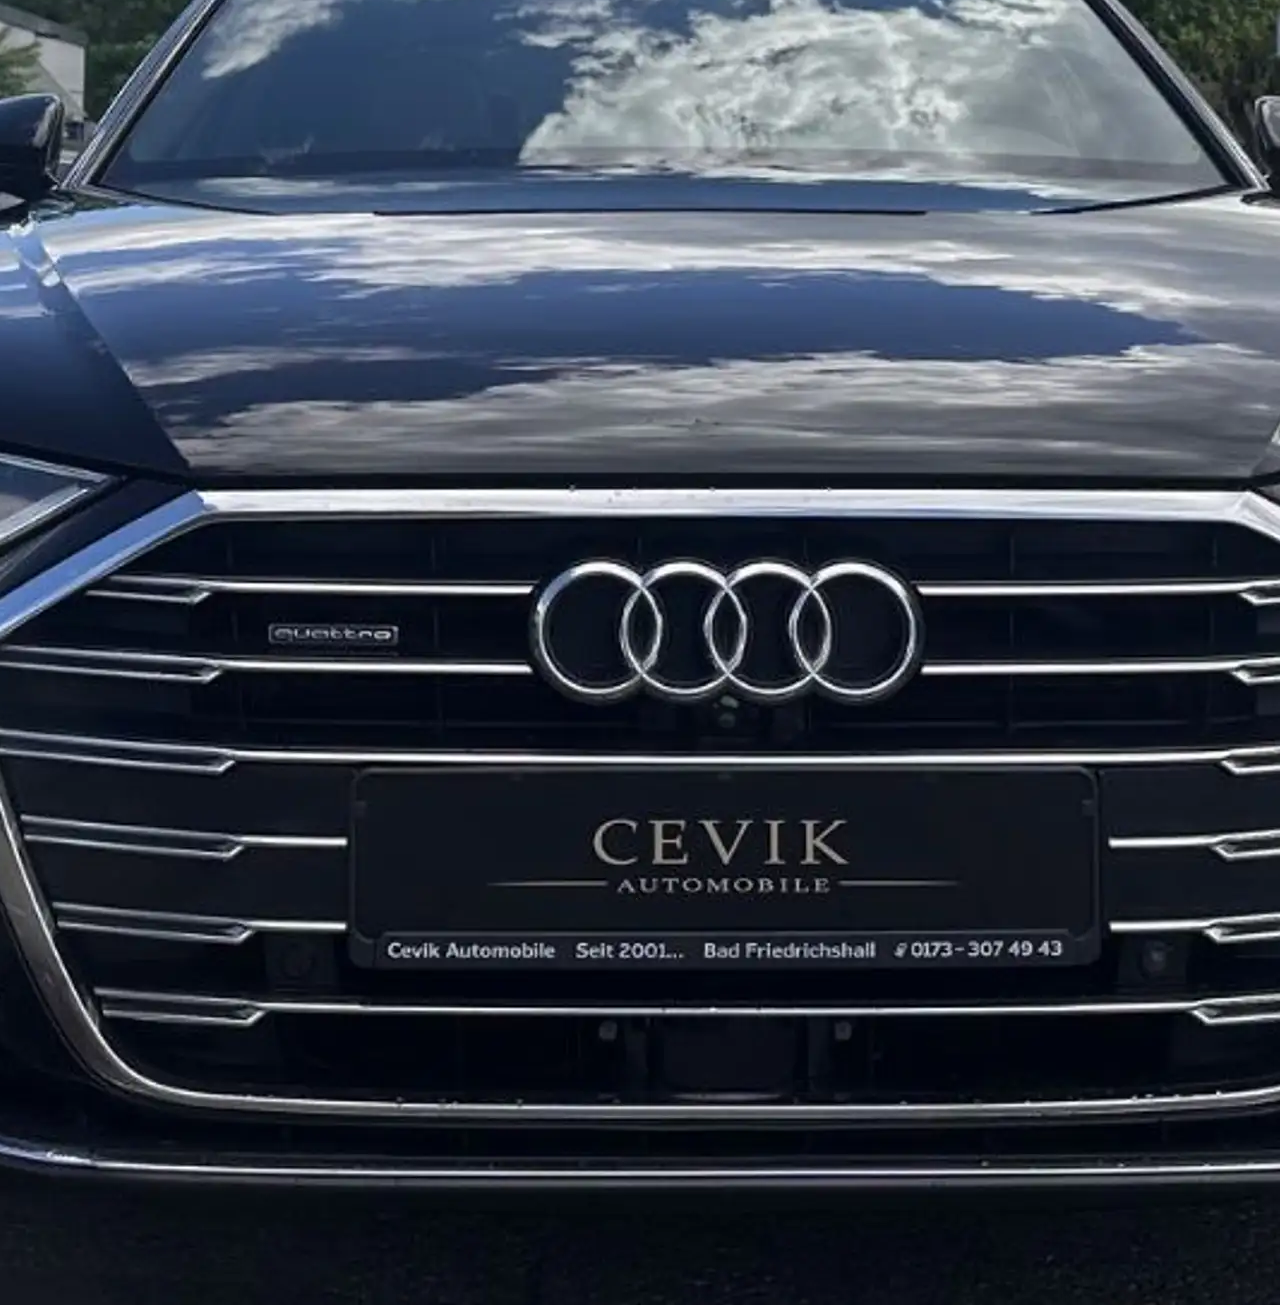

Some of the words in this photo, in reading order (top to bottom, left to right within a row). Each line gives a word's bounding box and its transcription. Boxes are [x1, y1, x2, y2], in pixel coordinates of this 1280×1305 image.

[273, 627, 392, 642] quattro
[592, 818, 850, 866] CEVIK
[617, 877, 831, 894] AUTOMOBILE
[387, 941, 440, 959] Cevik
[444, 941, 556, 959] Automobile
[574, 941, 614, 960] Seit
[704, 941, 740, 959] Bad
[744, 940, 877, 959] Friedrichshall
[1007, 939, 1034, 957] 49
[1036, 939, 1063, 957] 43
